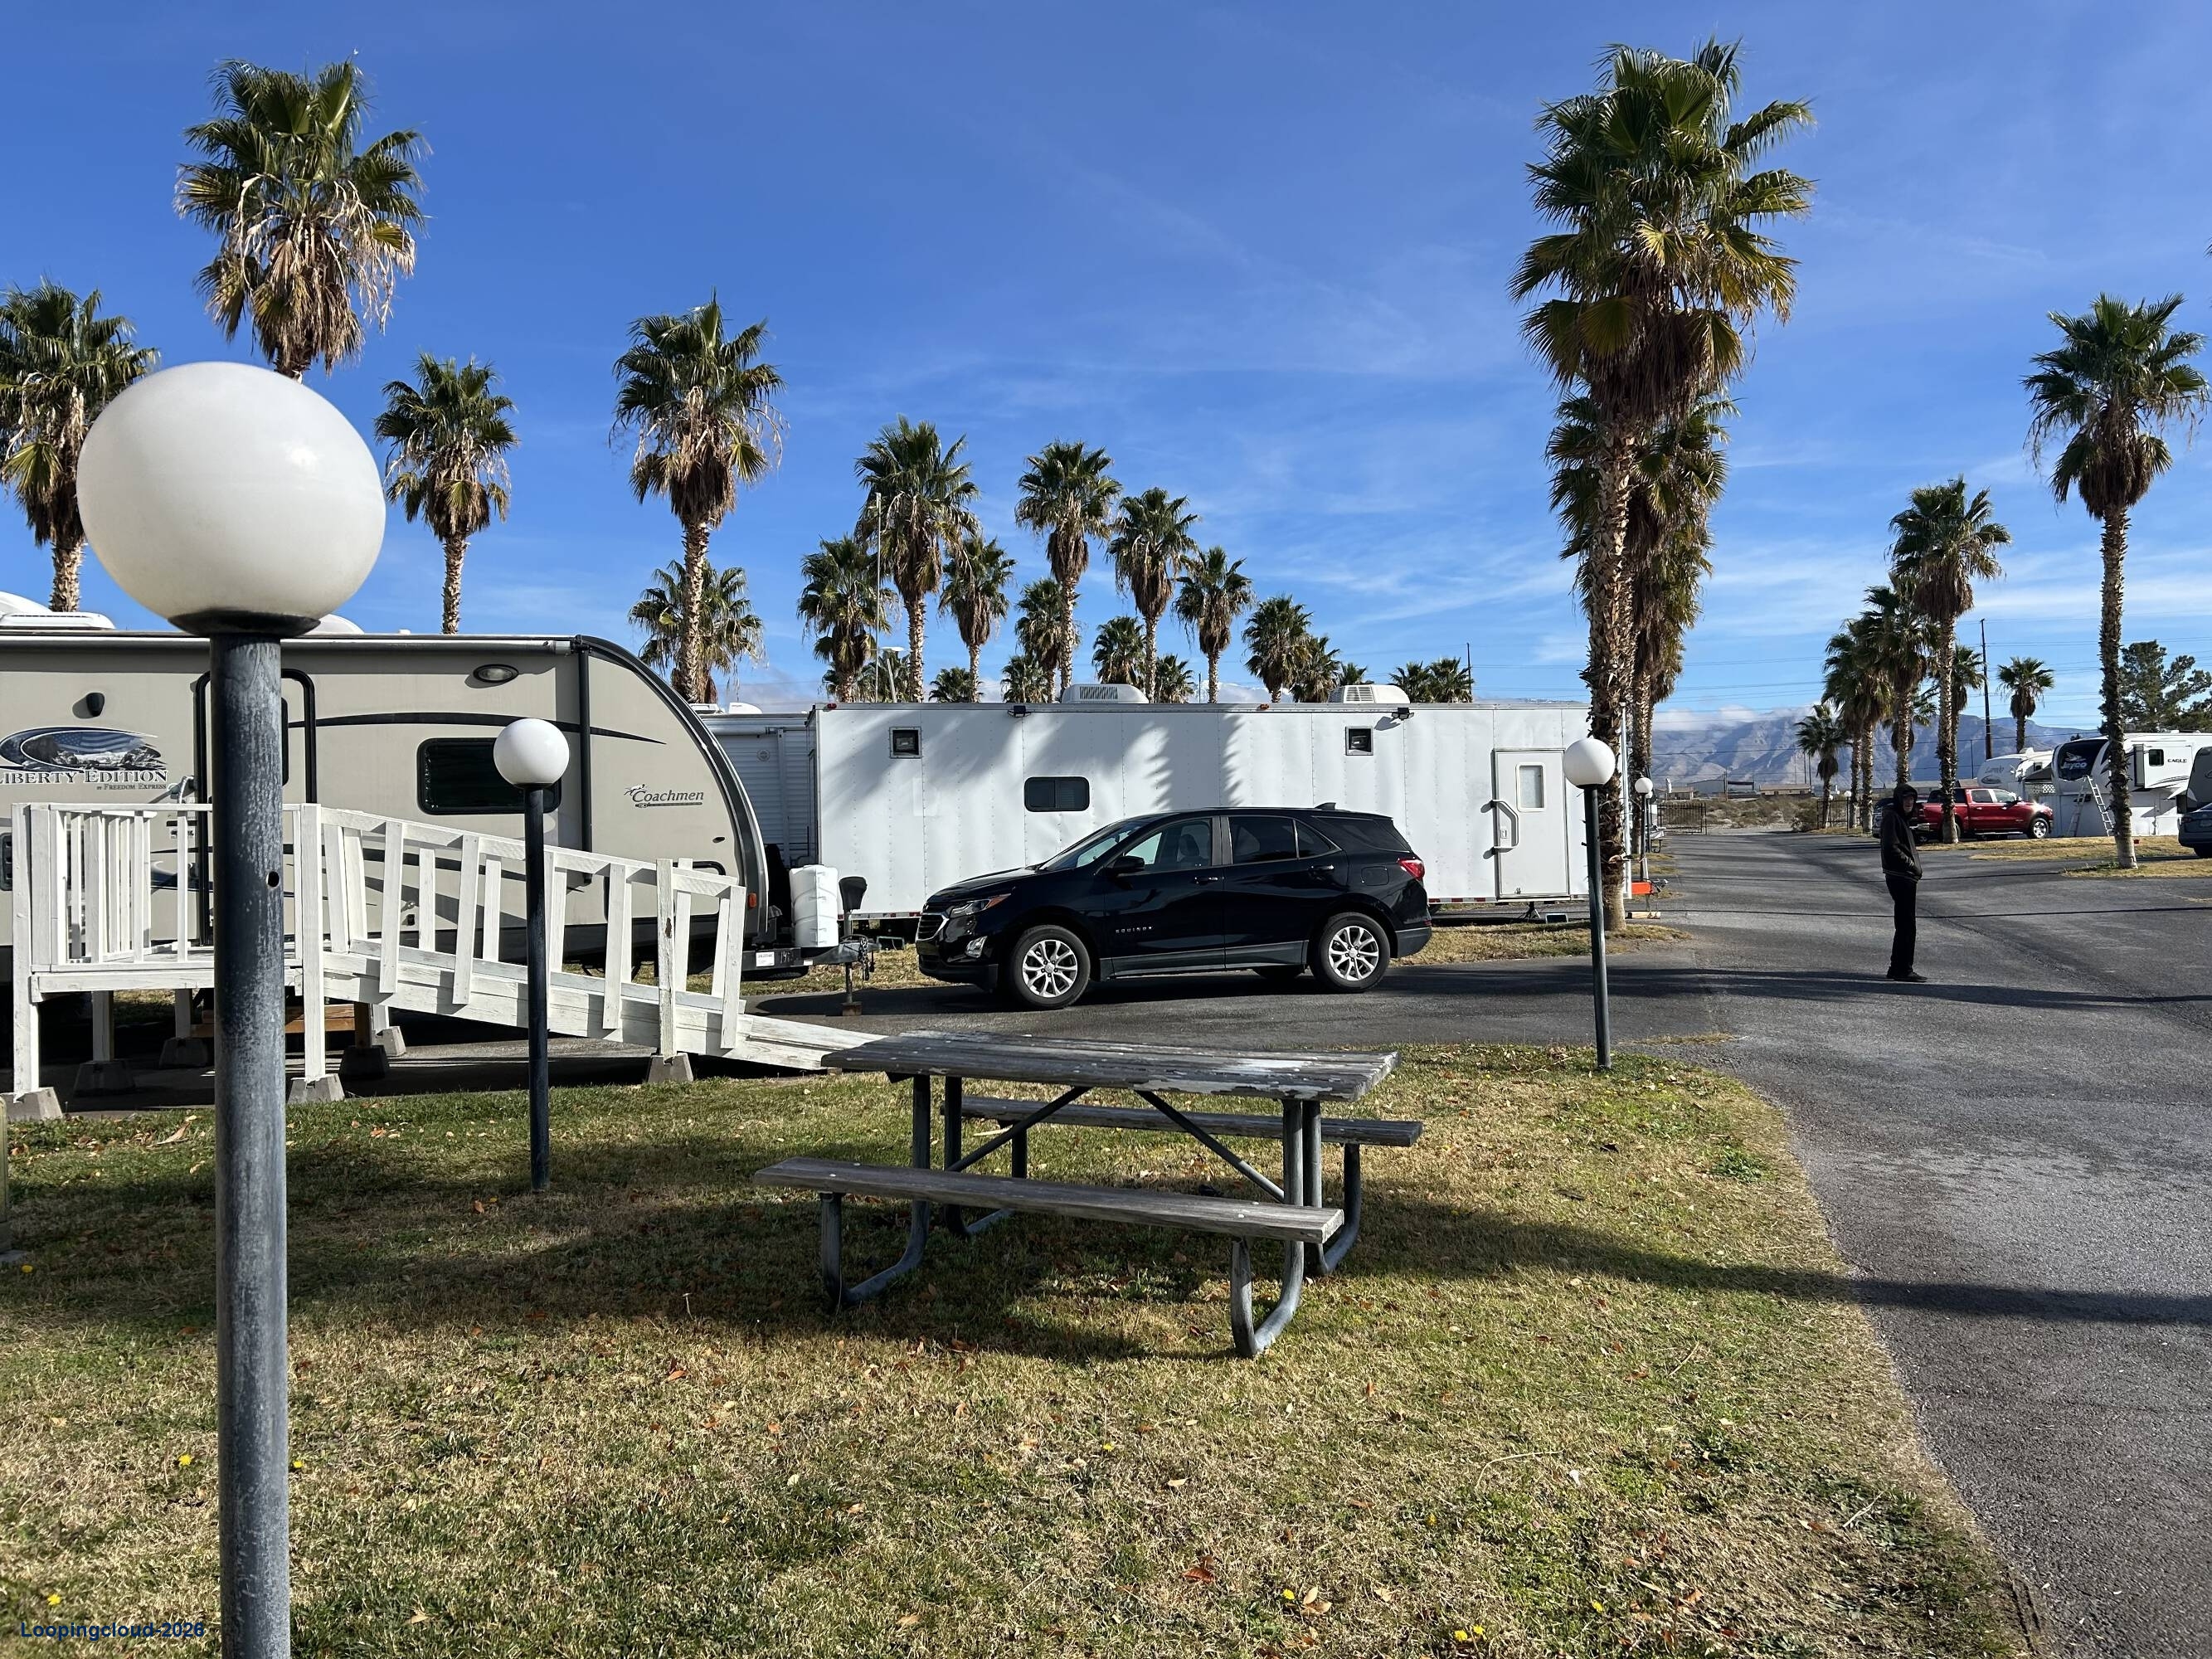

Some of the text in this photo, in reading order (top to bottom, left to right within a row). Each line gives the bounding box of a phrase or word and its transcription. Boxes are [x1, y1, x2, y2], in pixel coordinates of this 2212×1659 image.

[2061, 761, 2088, 770] Jayco
[0, 770, 168, 784] IBERTY EDITION
[632, 789, 704, 803] Coachmen
